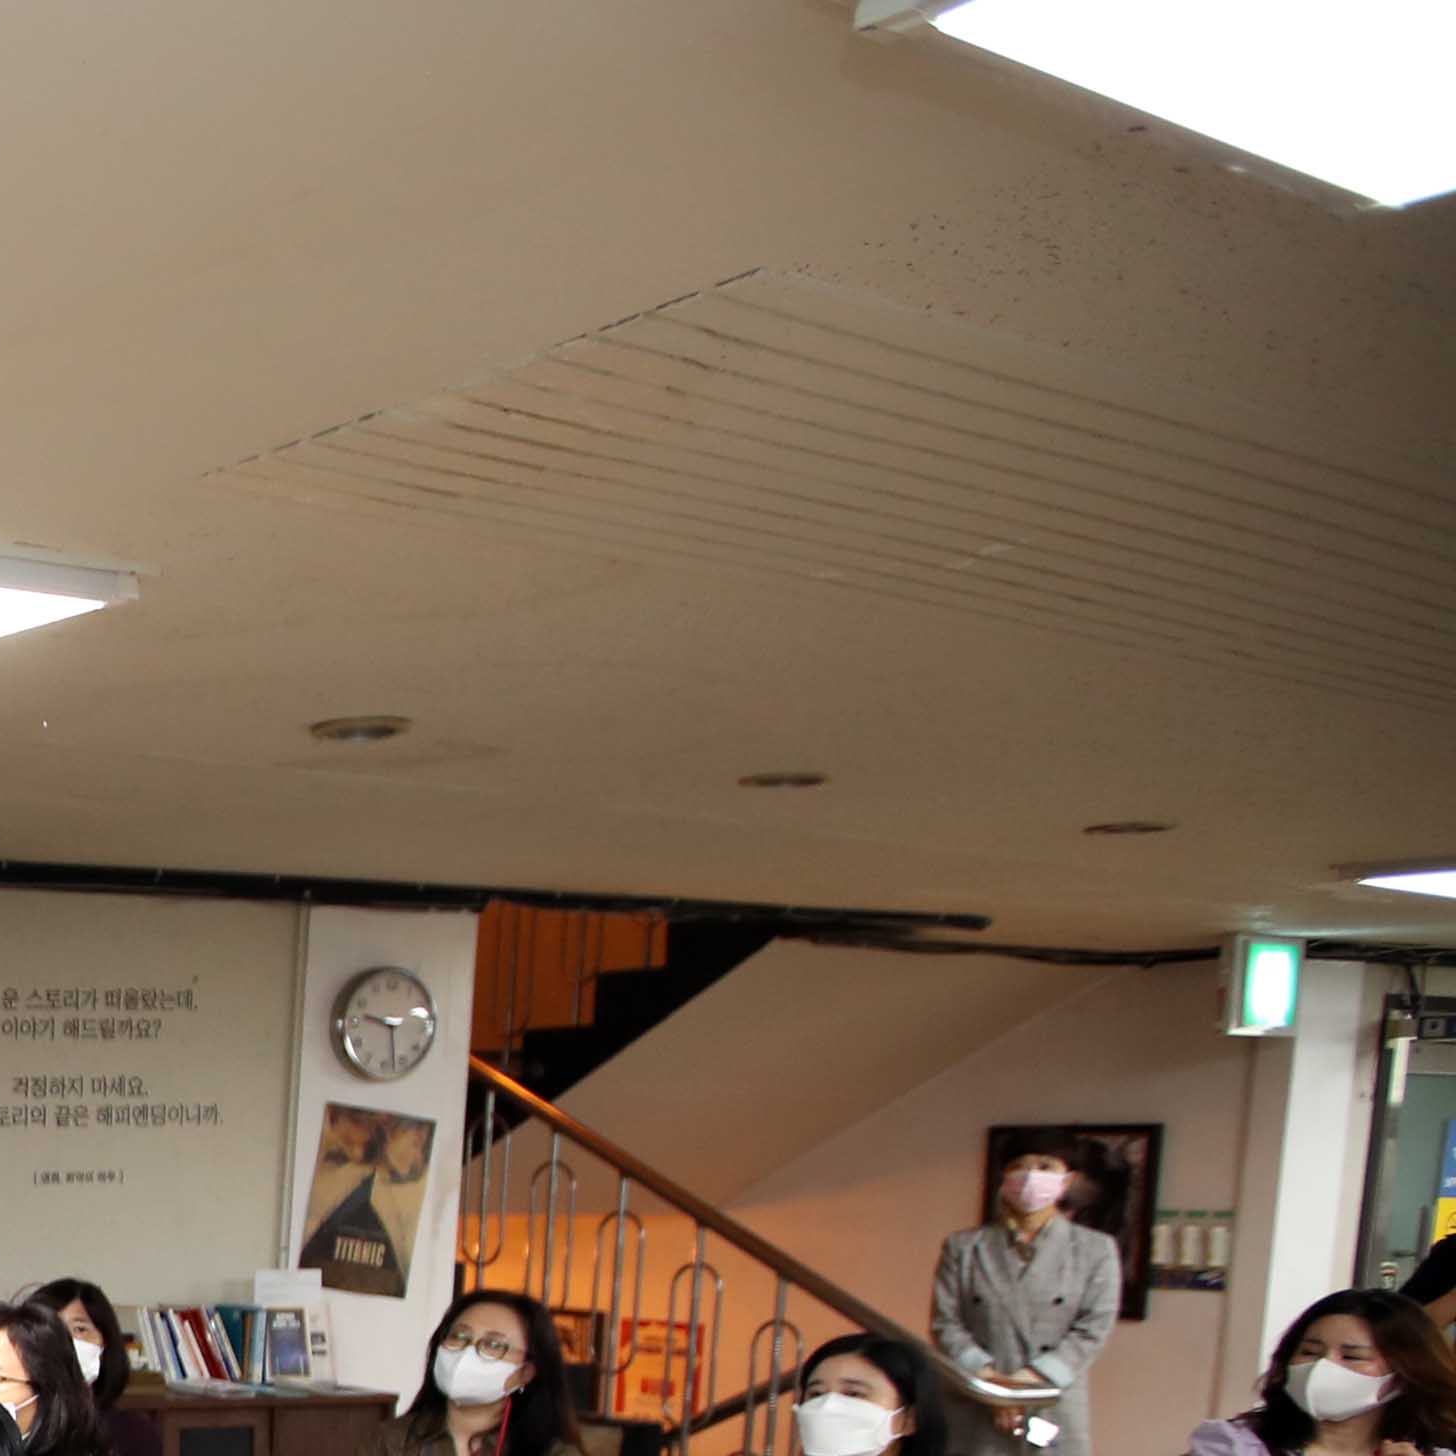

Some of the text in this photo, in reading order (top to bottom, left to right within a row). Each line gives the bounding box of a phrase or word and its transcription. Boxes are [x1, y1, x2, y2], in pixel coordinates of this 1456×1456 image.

[24, 986, 98, 1010] 스토리가
[1, 1016, 163, 1040] 이야기 해드릴까요?
[12, 1075, 149, 1098] 걱정하지 마세요.
[53, 1104, 90, 1128] 끝은
[333, 1235, 387, 1267] TITANIC
